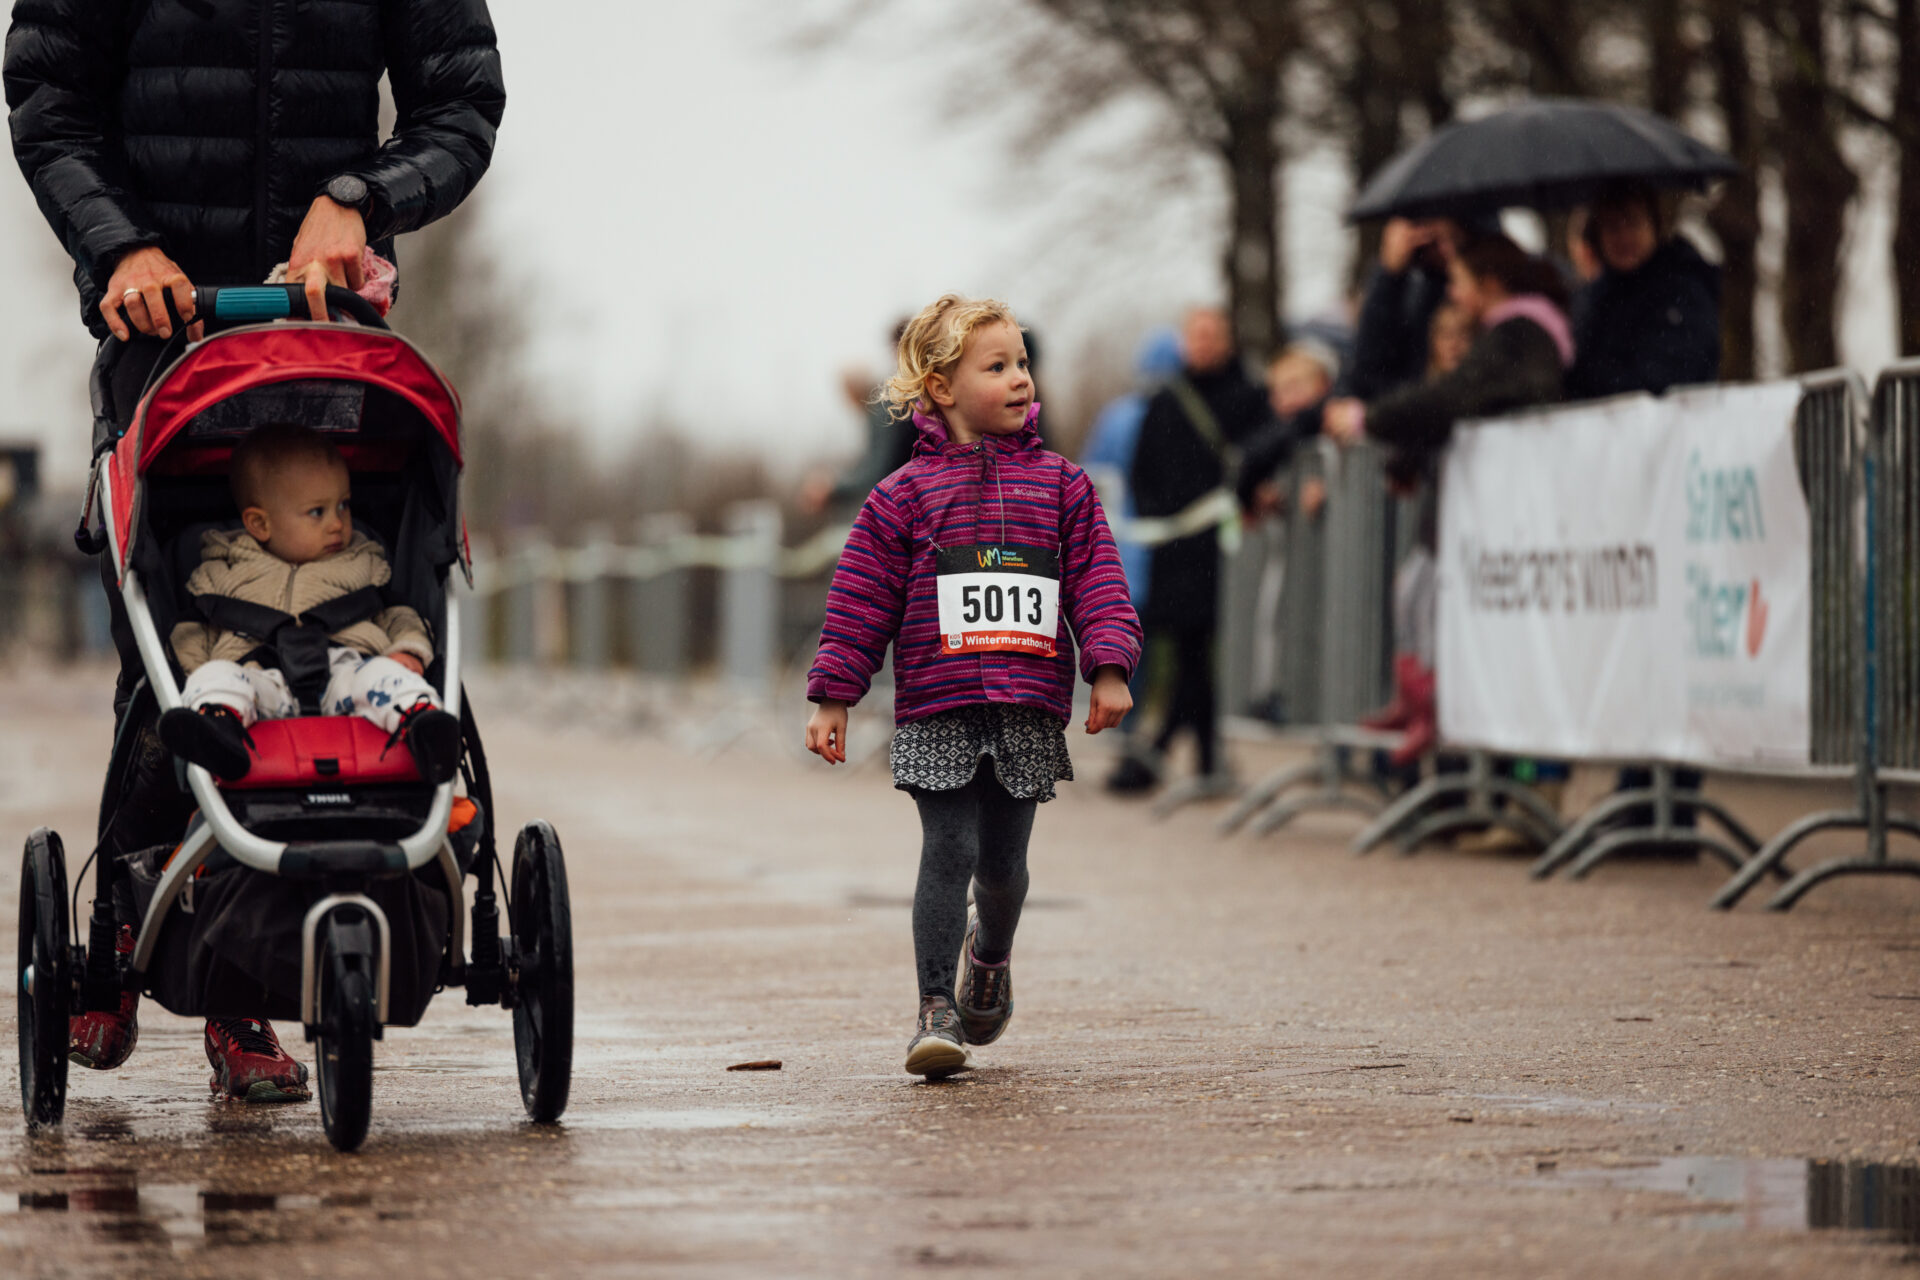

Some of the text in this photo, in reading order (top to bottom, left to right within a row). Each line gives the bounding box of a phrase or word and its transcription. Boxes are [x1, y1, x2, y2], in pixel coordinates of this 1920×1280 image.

[962, 584, 1042, 626] 5013
[965, 635, 1052, 652] Wintermarathon.frl
[307, 793, 351, 804] THULE
